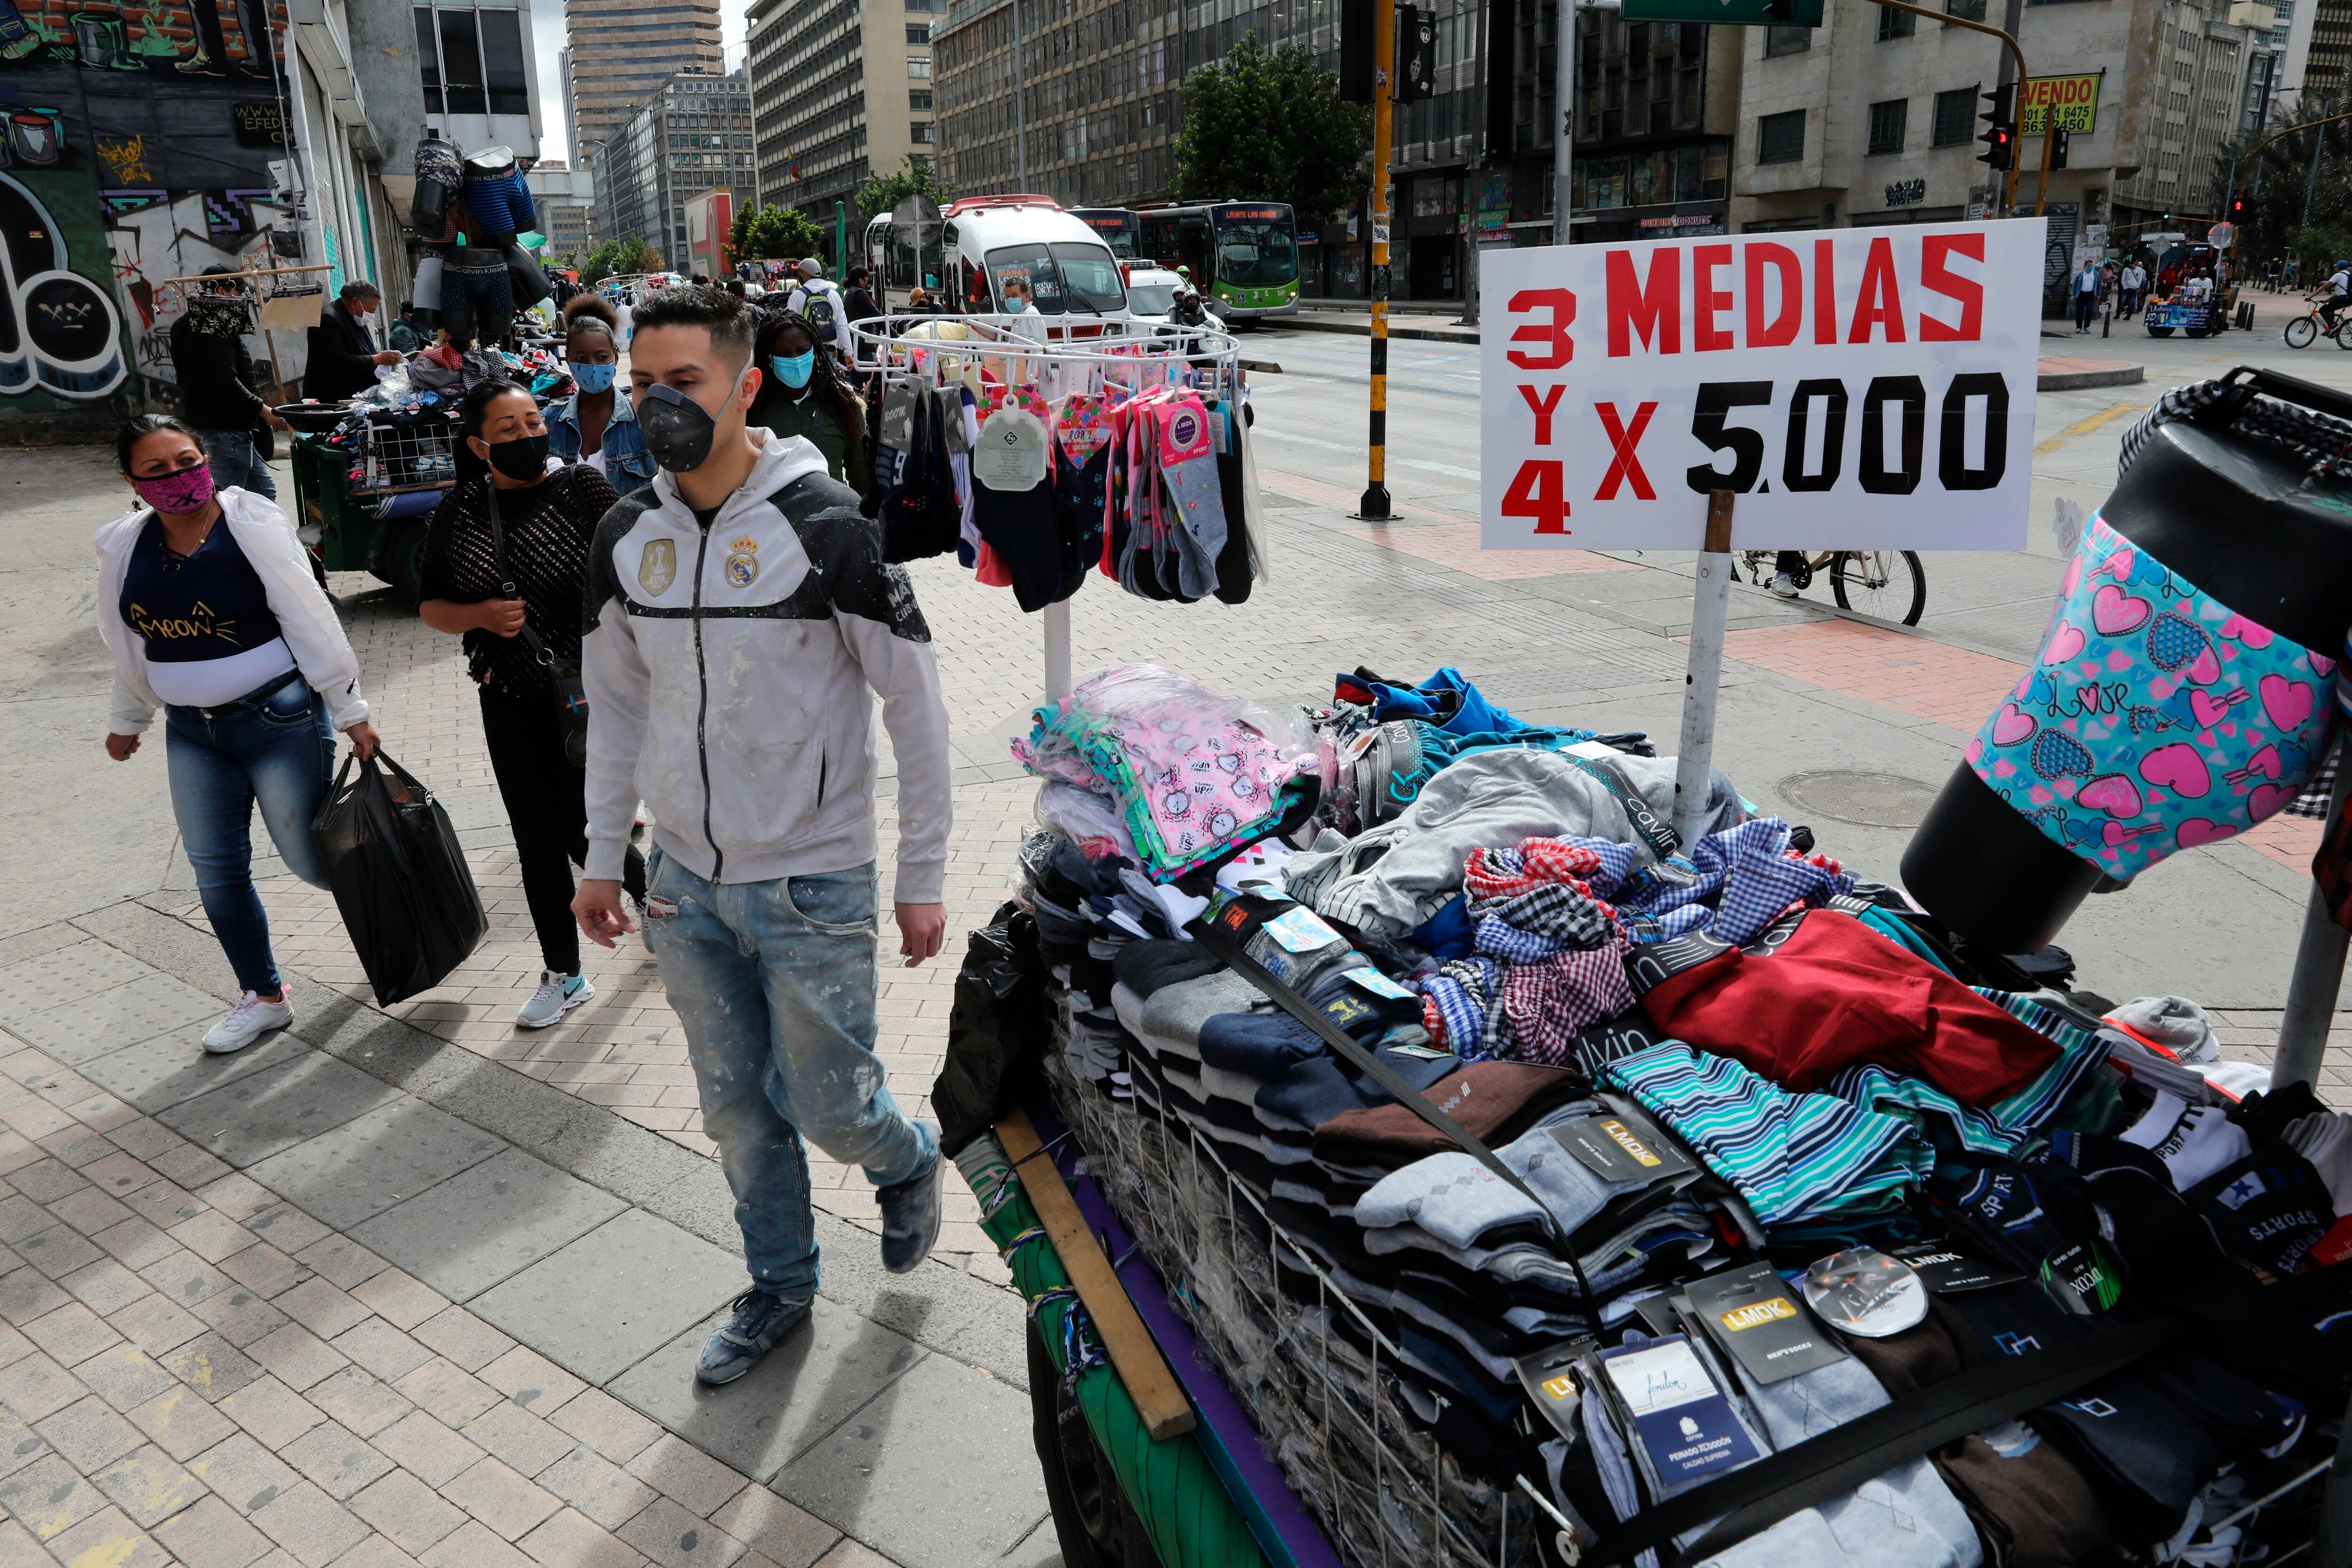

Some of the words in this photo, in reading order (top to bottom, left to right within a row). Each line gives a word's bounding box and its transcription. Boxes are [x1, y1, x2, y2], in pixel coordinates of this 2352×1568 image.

[2025, 79, 2092, 106] VENDO
[2064, 106, 2090, 118] 6475
[1677, 215, 1711, 226] DONUTS
[1606, 233, 1985, 358] MEDIAS
[1507, 287, 1576, 370] 3
[884, 405, 906, 422] BOOM
[1177, 420, 1193, 429] LMOK
[1517, 384, 1566, 446] Y
[1593, 401, 1659, 501] X
[1686, 372, 2009, 494] 5.000
[1193, 446, 1208, 454] SPORT
[1501, 459, 1572, 535] 4
[895, 603, 913, 622] CLUB
[1195, 786, 1214, 795] UP!!
[1390, 770, 1422, 802] CK
[1628, 798, 1677, 856] Cavlin
[1606, 1124, 1654, 1162] LMOK
[1593, 1151, 1613, 1167] SOCKS
[1980, 1175, 2014, 1218] SPORT
[2248, 1209, 2319, 1242] SPORTS
[1903, 1252, 1963, 1267] LMOK
[2276, 1226, 2327, 1274] SPORTS
[1727, 1302, 1787, 1327] LMOK
[1766, 1348, 1789, 1360] MEN'S
[1788, 1342, 1812, 1353] SOCKS
[1669, 1447, 1700, 1462] PEINADO
[1697, 1436, 1732, 1453] ALGODÓN
[1685, 1432, 1704, 1442] COTTON
[1704, 1449, 1732, 1463] SUPREMA
